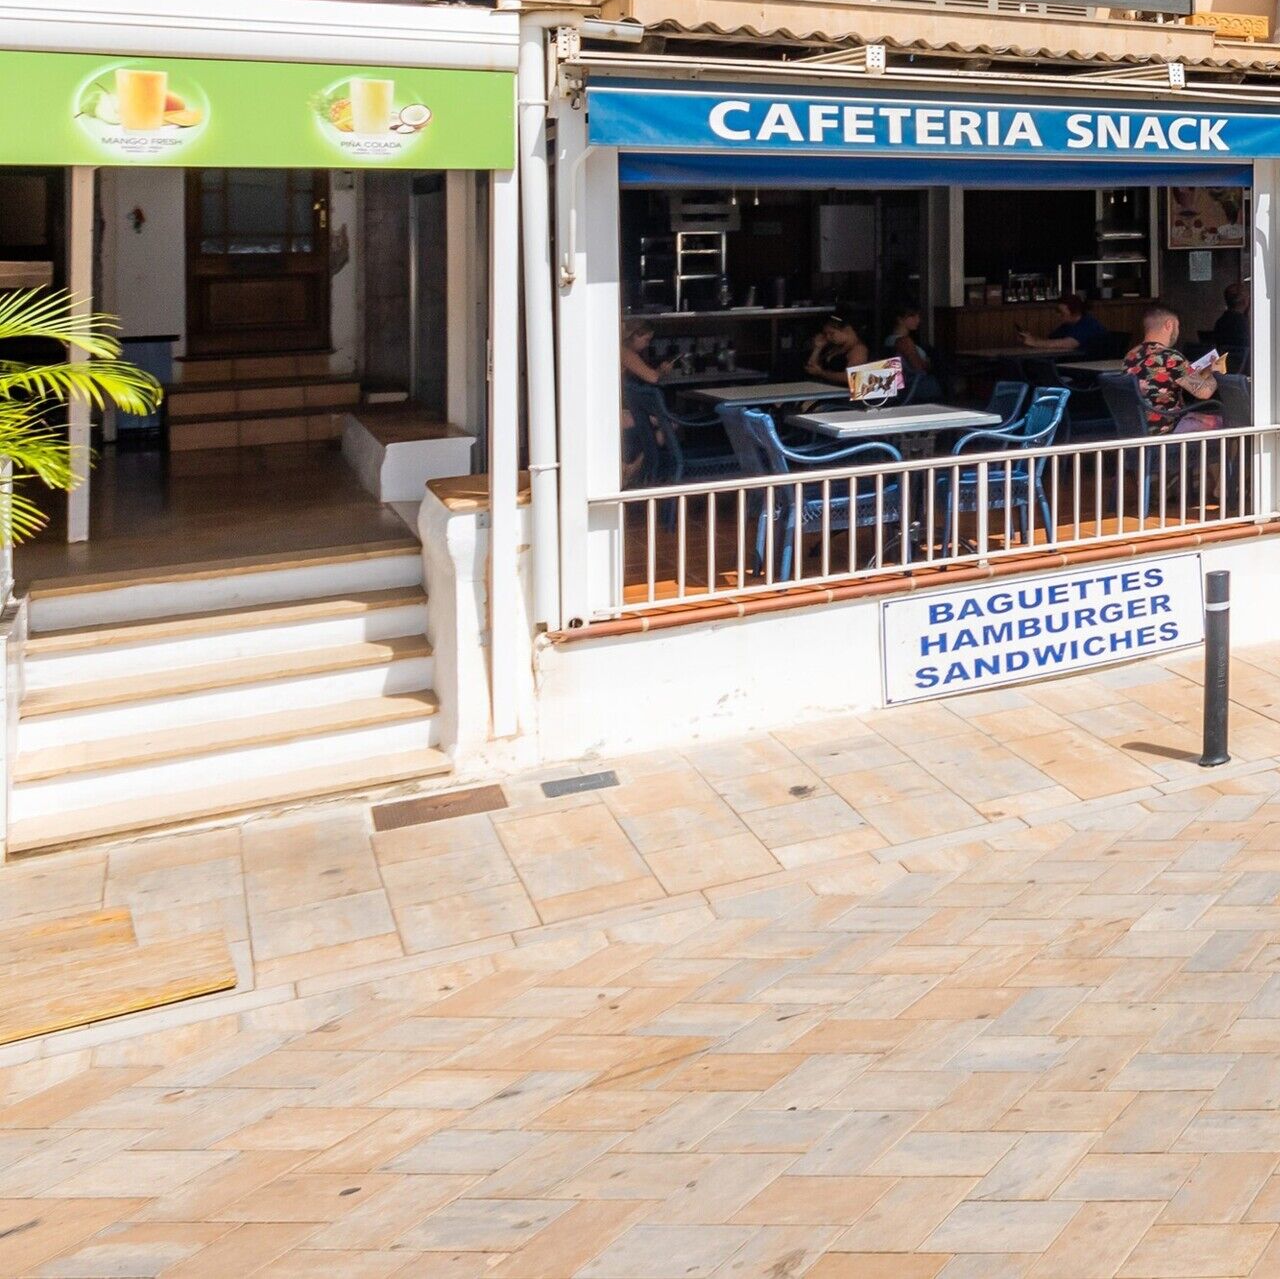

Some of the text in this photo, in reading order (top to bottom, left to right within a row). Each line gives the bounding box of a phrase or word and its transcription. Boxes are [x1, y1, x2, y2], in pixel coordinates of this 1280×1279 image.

[101, 137, 147, 145] MANGO
[341, 140, 361, 148] PIÑA
[707, 100, 1230, 151] CAFETERIA SNACK
[928, 568, 1164, 625] BAGUETTES
[920, 594, 1173, 656] HAMBURGER
[915, 621, 1179, 689] SANDWICHES
